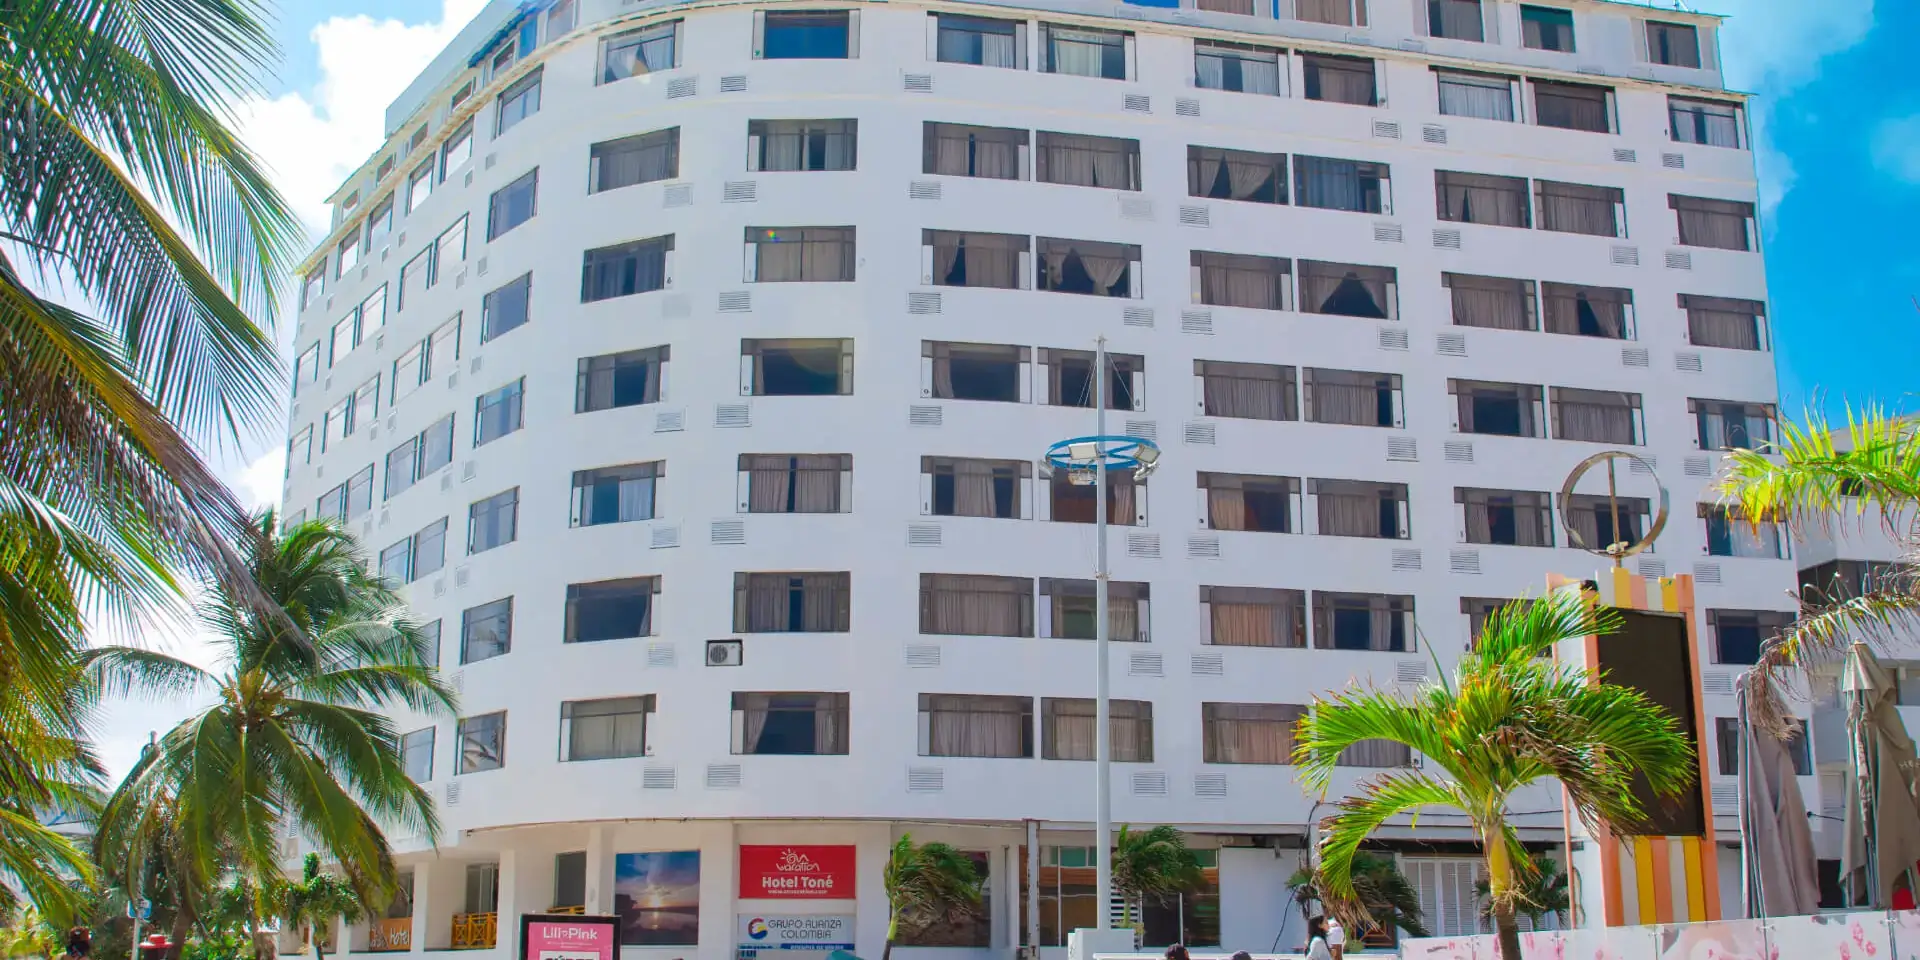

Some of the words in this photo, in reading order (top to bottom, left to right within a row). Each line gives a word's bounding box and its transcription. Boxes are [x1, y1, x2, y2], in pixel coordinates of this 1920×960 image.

[762, 876, 798, 888] Hotel
[801, 874, 833, 888] Toné
[768, 919, 802, 929] GRUPO
[805, 919, 841, 929] ALIANZA
[568, 928, 598, 940] Pink
[780, 930, 831, 939] COLOMBIA
